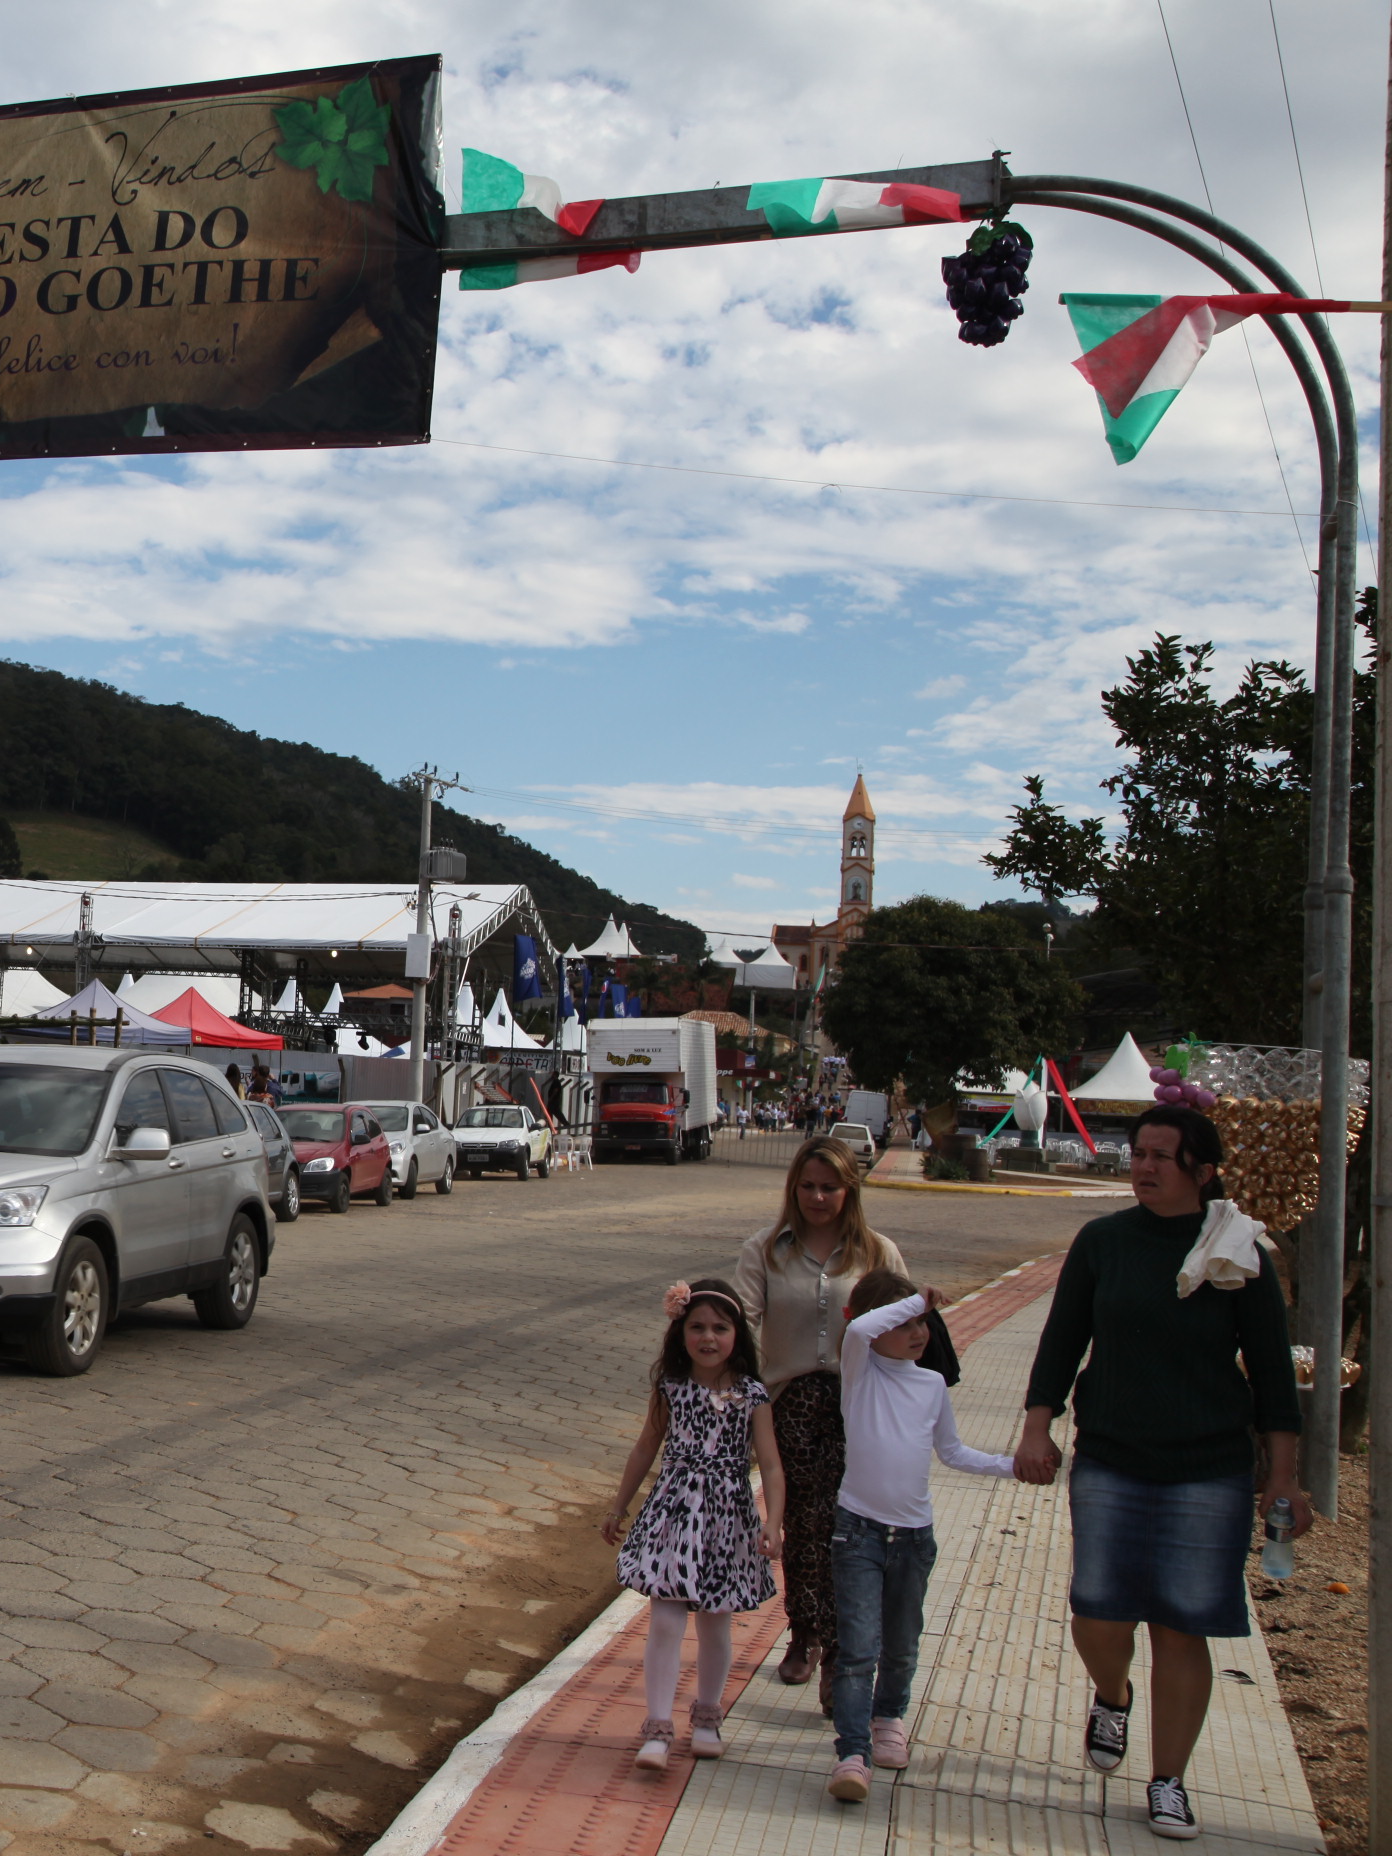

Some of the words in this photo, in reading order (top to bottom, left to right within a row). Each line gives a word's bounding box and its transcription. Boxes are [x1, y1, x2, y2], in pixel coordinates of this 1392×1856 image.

[105, 110, 278, 206] Vindos
[148, 206, 249, 253] DO
[36, 257, 320, 316] GOETHE
[95, 350, 156, 369] con
[172, 323, 240, 364] voi!
